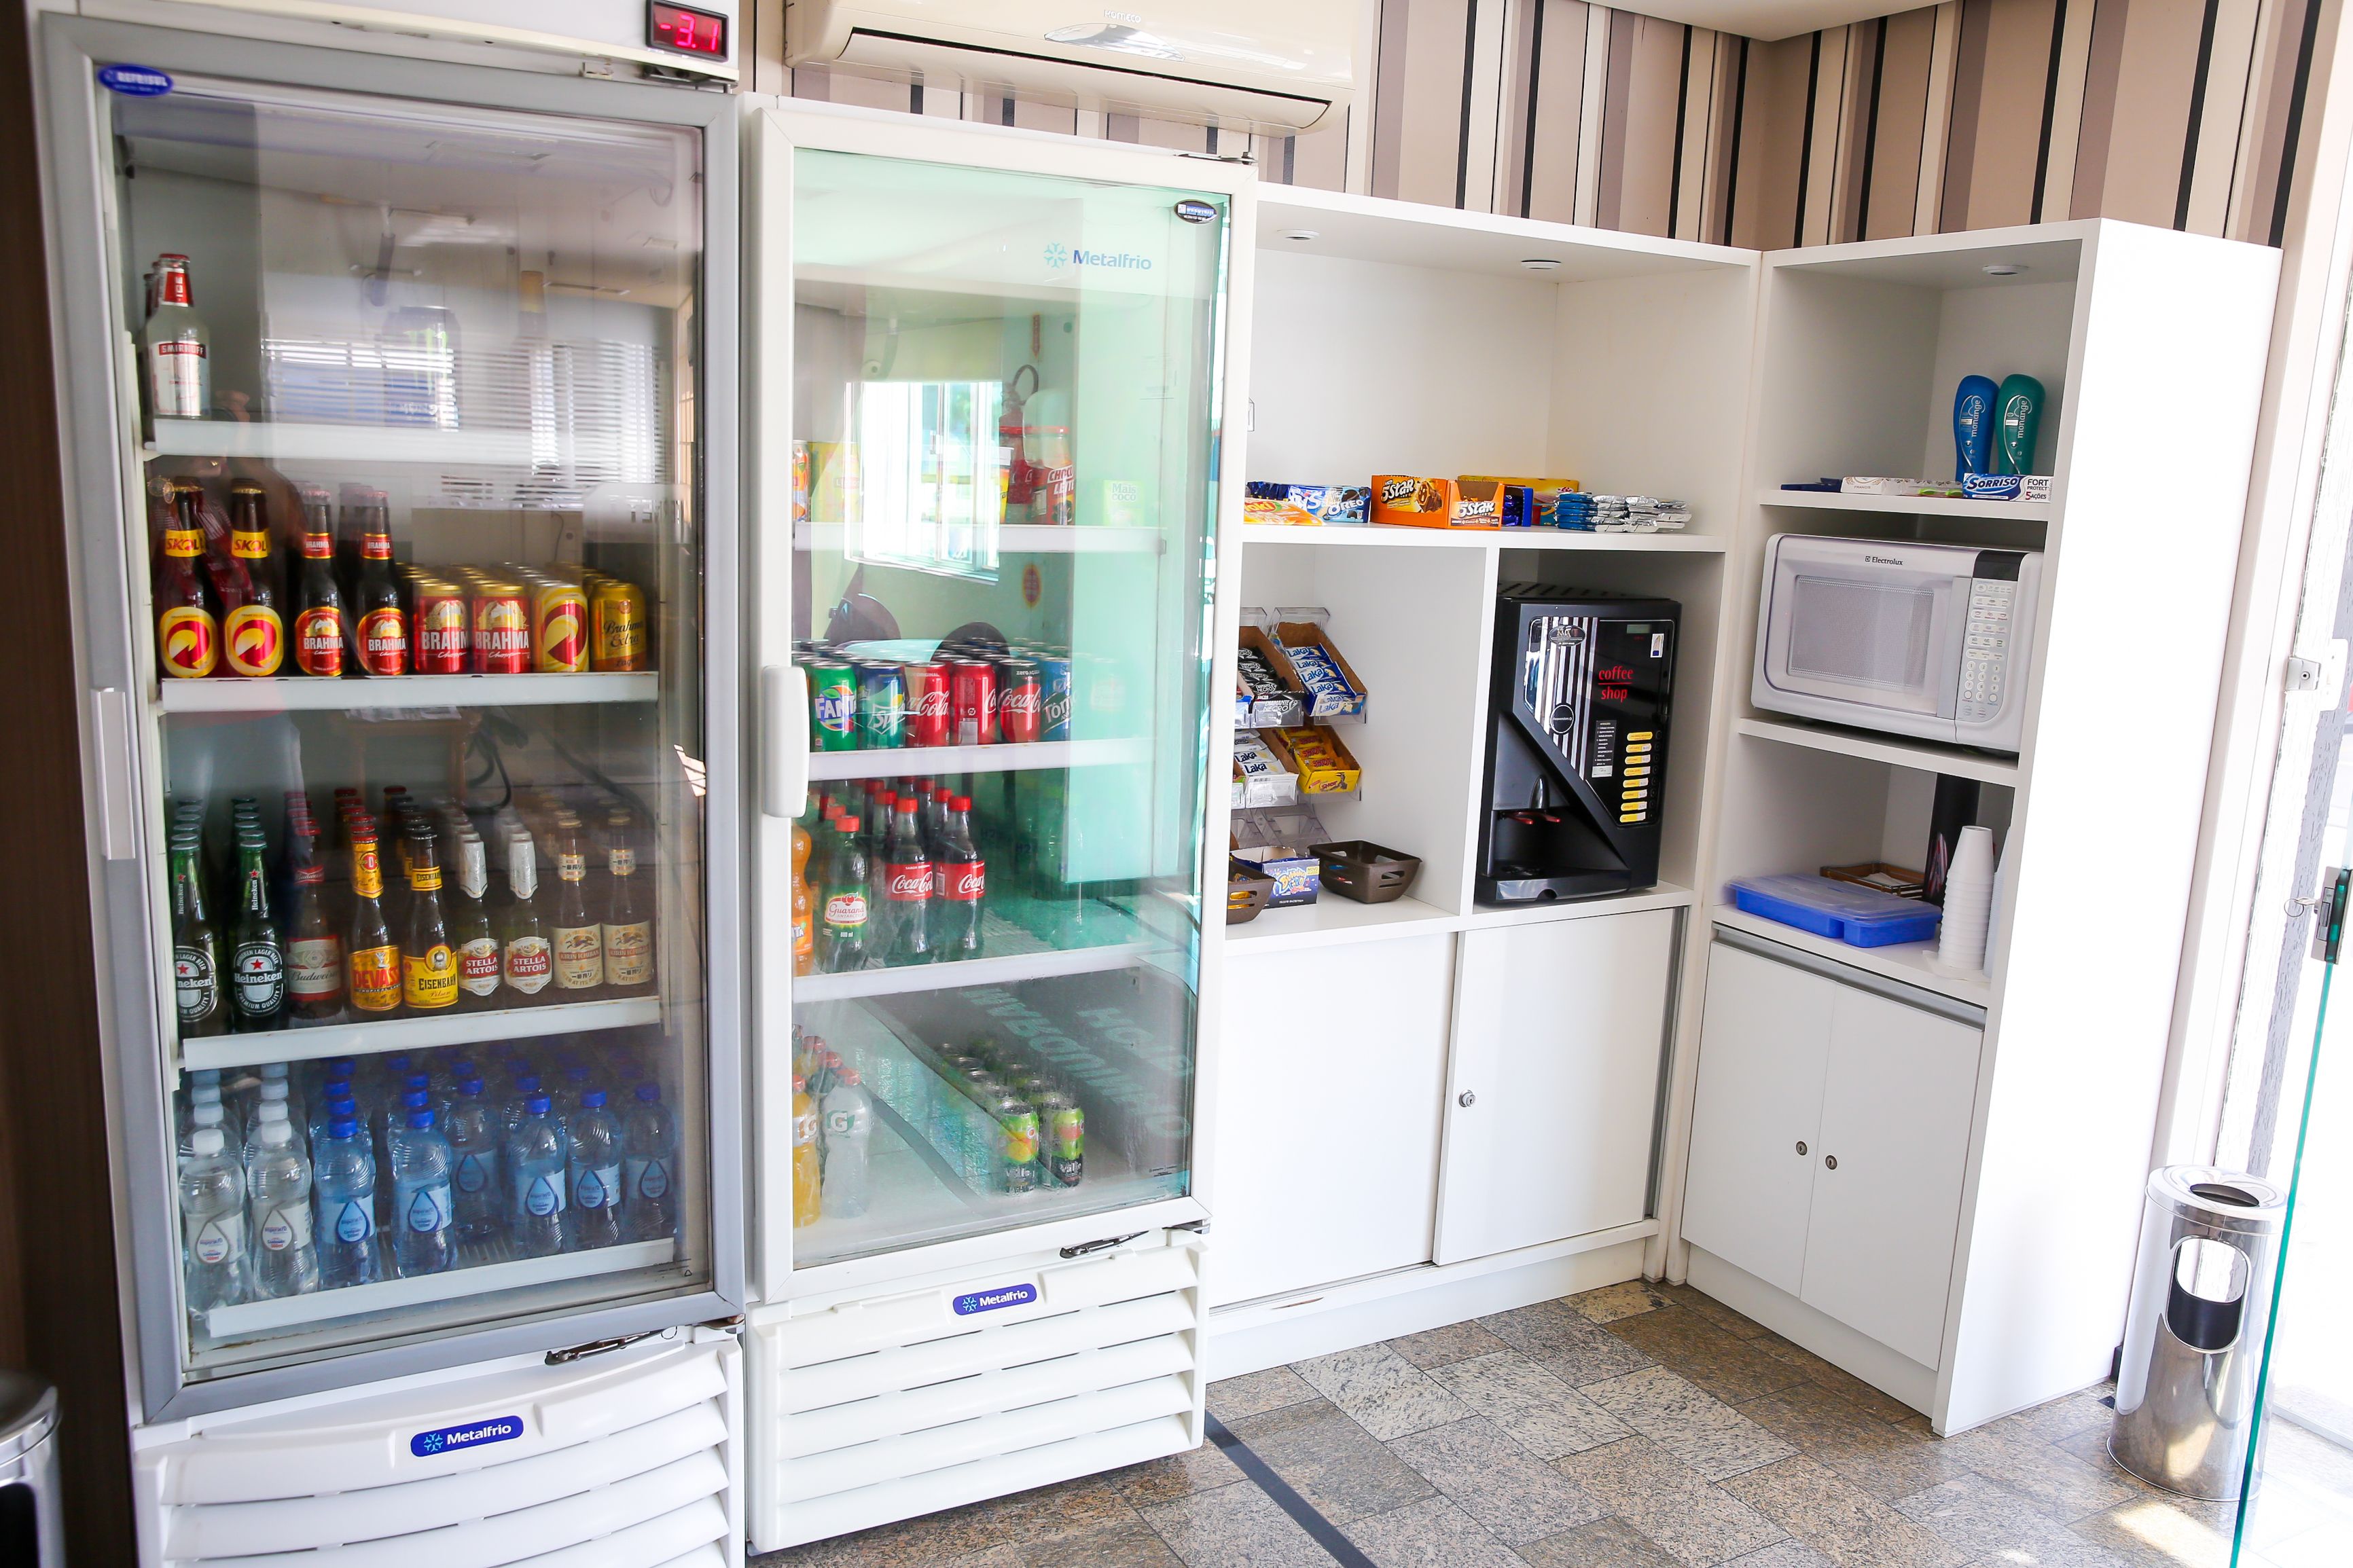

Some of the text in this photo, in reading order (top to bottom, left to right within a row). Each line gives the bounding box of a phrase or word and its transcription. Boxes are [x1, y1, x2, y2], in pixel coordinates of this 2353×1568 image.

[658, 14, 719, 52] -3.1
[1073, 249, 1152, 270] Metalfrio
[162, 344, 204, 355] SMIRNOFF
[1971, 399, 1982, 437] monange
[2017, 400, 2029, 438] monange
[1112, 483, 1136, 494] Mais
[1966, 477, 2018, 490] SORRISO
[1245, 502, 1272, 511] oki
[1328, 500, 1364, 516] OREO
[166, 538, 200, 551] SKOL
[234, 539, 266, 551] SKOL
[1871, 556, 1903, 566] Electrolux
[304, 637, 344, 649] BRAHMA
[368, 638, 406, 651] BRAHMA
[421, 631, 469, 650] BRAHM
[475, 631, 529, 650] BRAHMA
[1287, 647, 1308, 658] Laka
[1296, 659, 1317, 669] Laka
[1301, 668, 1324, 683] Laka
[1598, 666, 1634, 680] coffee
[1311, 682, 1333, 694] Laka
[1601, 686, 1628, 702] shop
[1263, 704, 1289, 712] NEGRO
[1319, 702, 1340, 714] Laka
[1234, 752, 1257, 763] Laka
[1244, 763, 1268, 773] Laka
[891, 871, 933, 894] Coca-Col
[466, 956, 497, 967] STELLA
[514, 955, 545, 966] STELLA
[466, 964, 498, 974] ARTOIS
[514, 963, 546, 972] ARTOIS
[177, 977, 213, 988] neken
[234, 970, 283, 983] Heineken
[418, 973, 456, 991] EISENBAHN
[979, 1290, 1028, 1307] Metalfrio
[447, 1423, 512, 1445] Metalfrio
